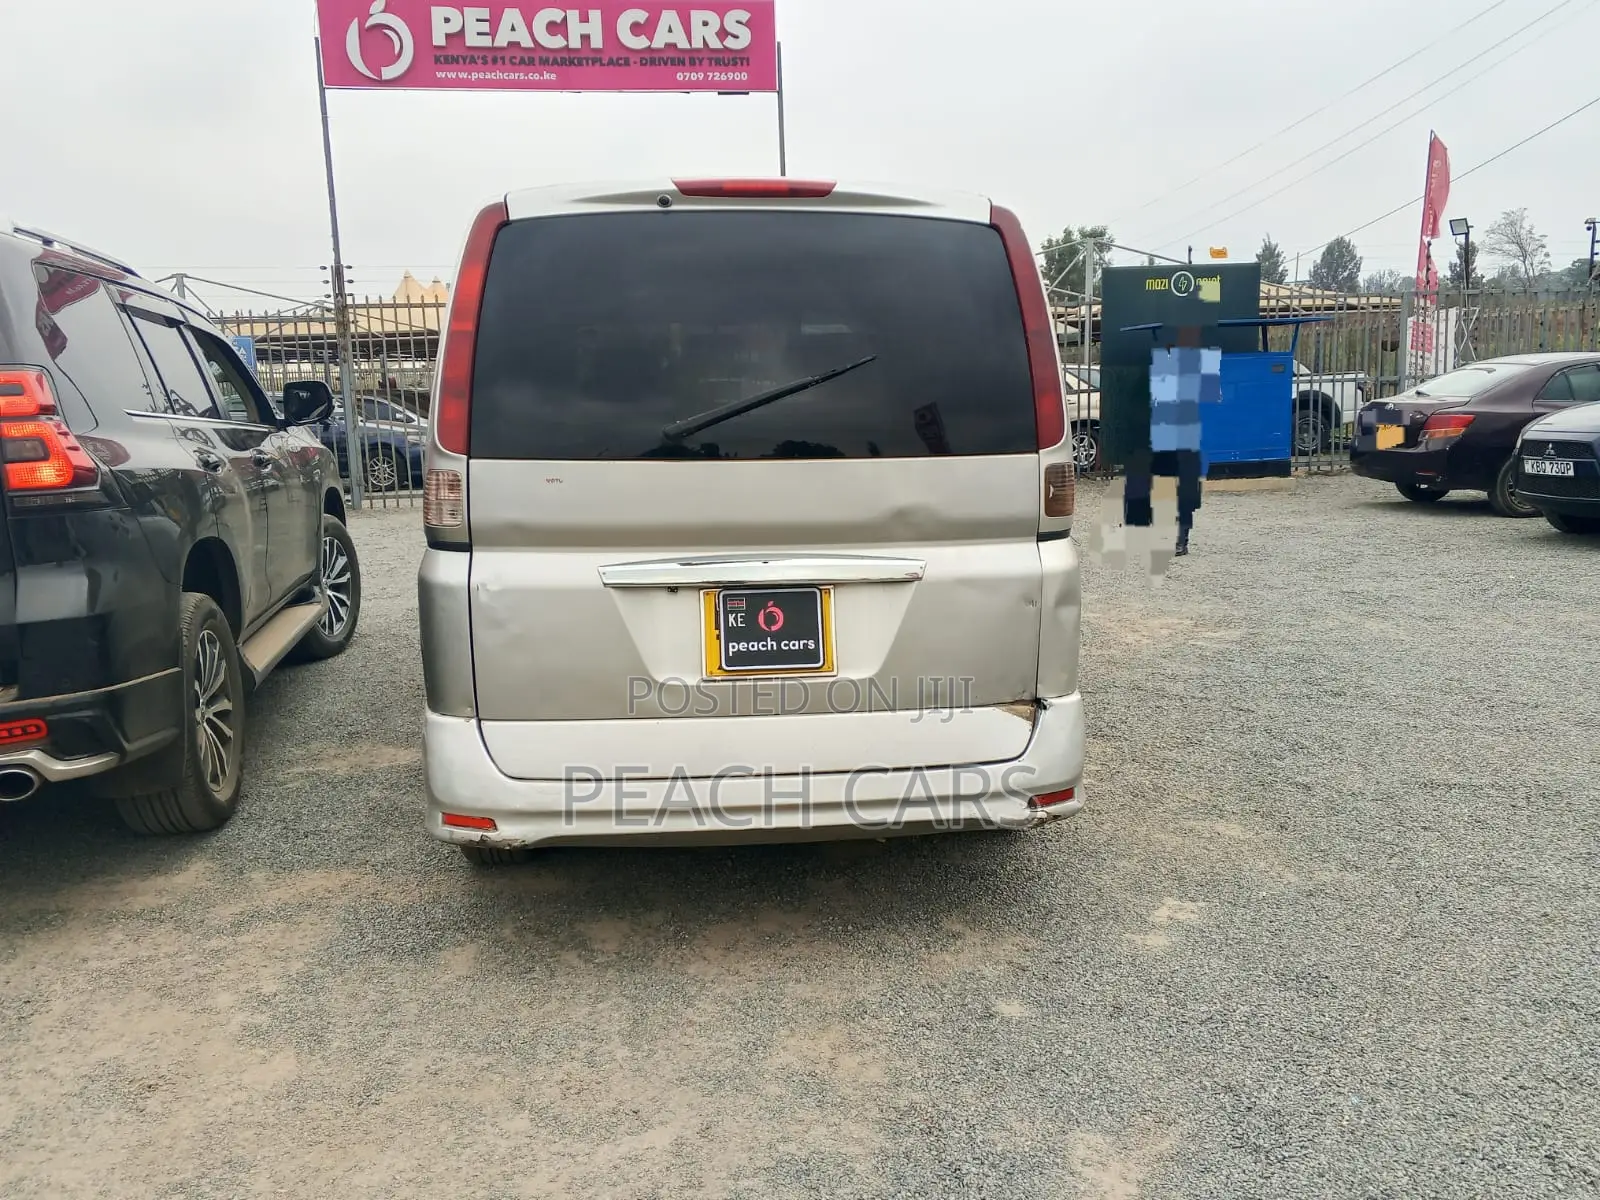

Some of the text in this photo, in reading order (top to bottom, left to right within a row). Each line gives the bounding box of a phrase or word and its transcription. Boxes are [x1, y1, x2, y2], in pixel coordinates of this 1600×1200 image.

[430, 6, 752, 50] PEACH CARS
[434, 54, 488, 66] KENYA'S
[491, 55, 506, 66] #1
[509, 55, 536, 67] CAR
[538, 56, 630, 67] MARKETPLACE
[639, 56, 686, 67] DRIVEN
[688, 56, 705, 67] BY
[435, 70, 557, 81] www.peachcars.co.ke
[676, 72, 748, 81] 0709 726900
[728, 613, 746, 627] KE
[728, 637, 815, 656] peach cars
